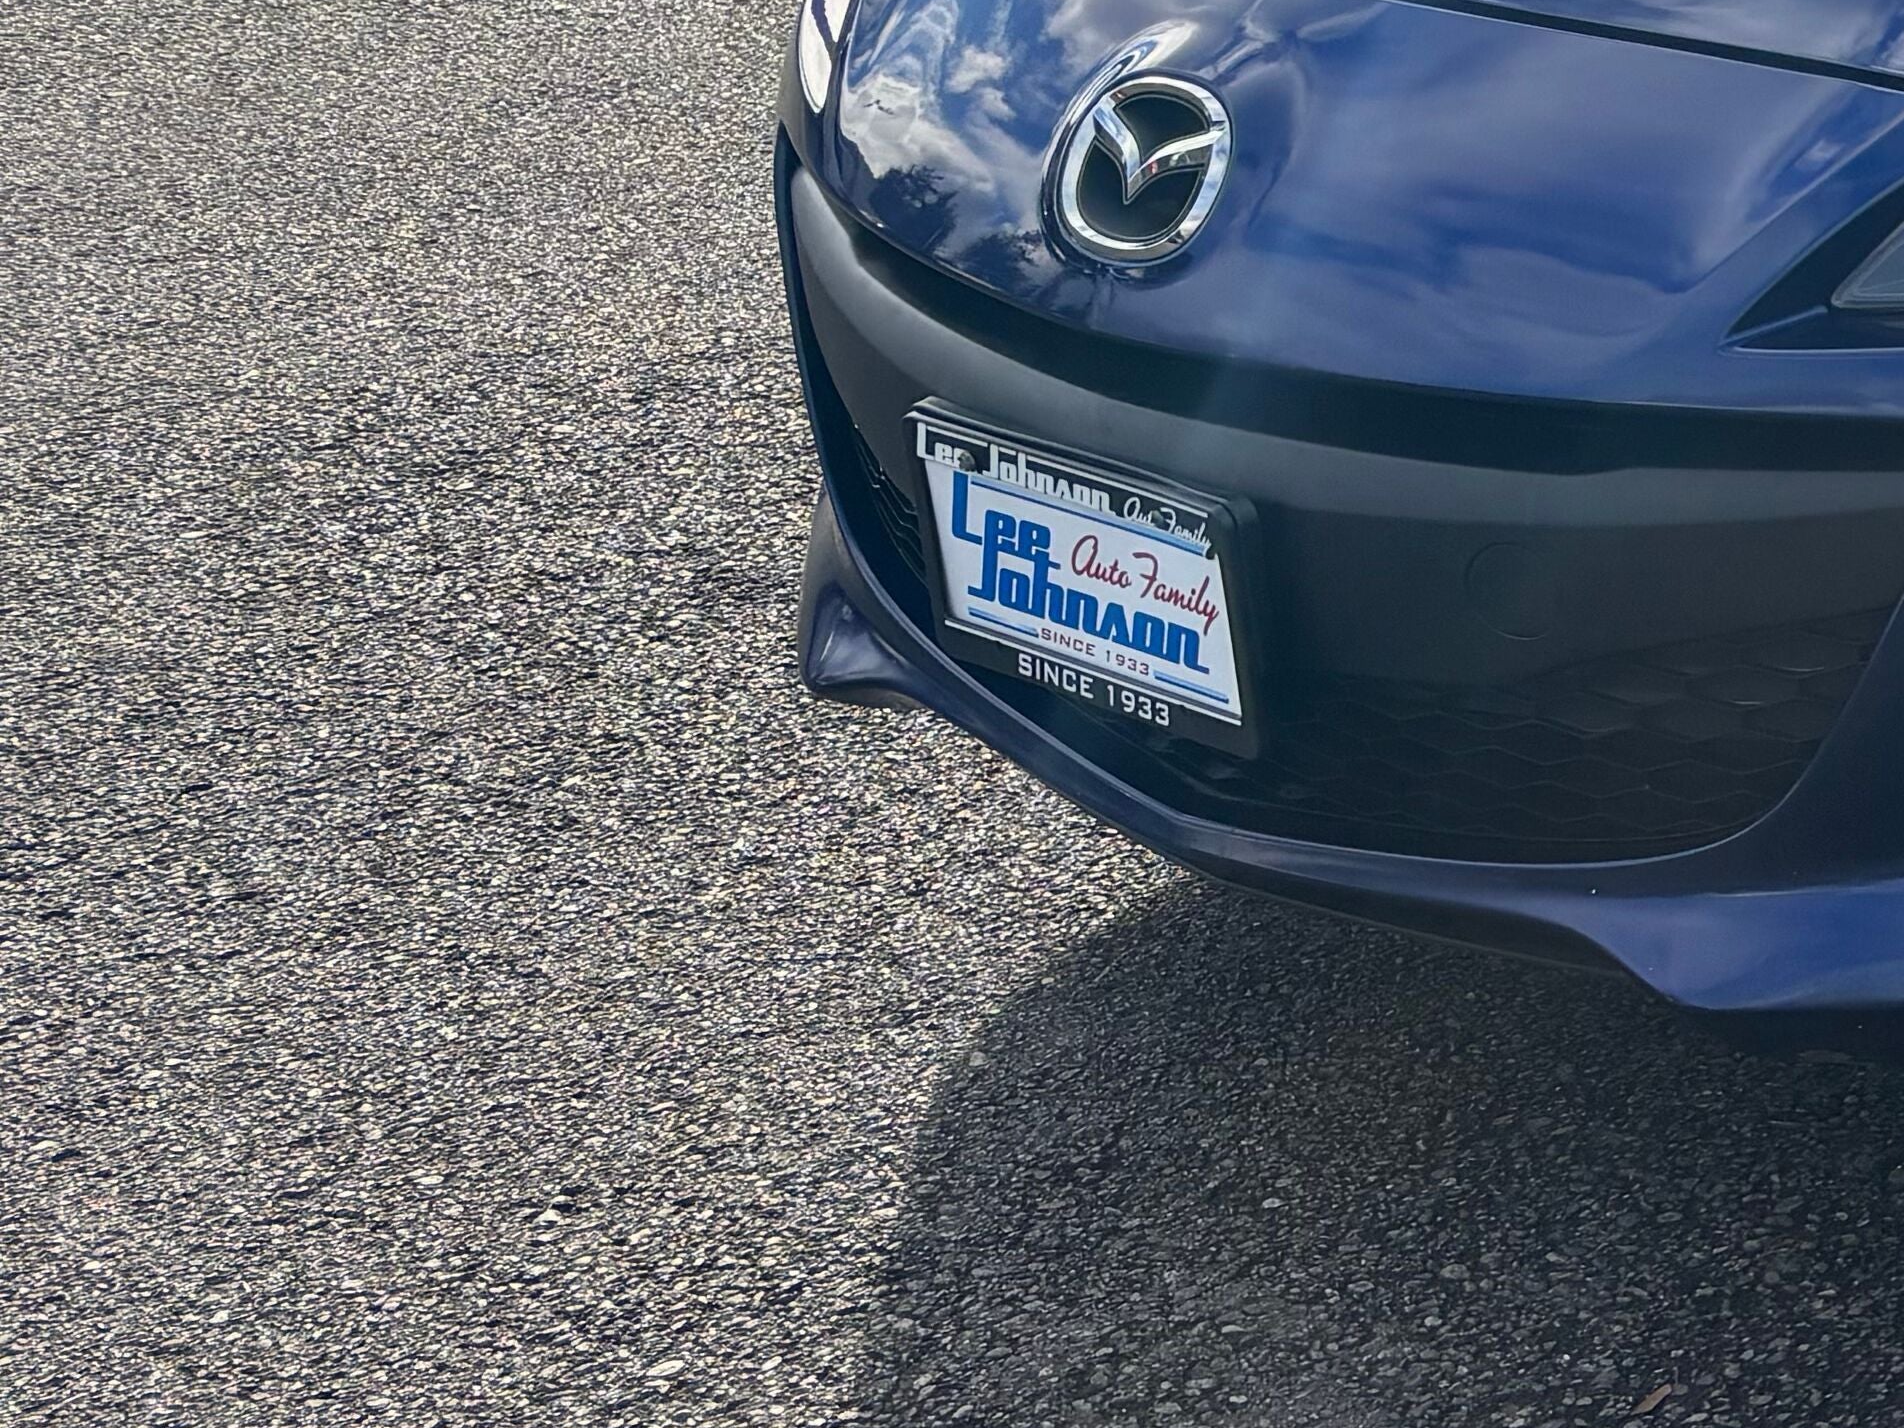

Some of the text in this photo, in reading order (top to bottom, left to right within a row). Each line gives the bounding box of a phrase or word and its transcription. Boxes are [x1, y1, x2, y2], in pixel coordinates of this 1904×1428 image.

[952, 471, 1220, 635] Lee Auto Family
[982, 443, 1117, 517] Johnson
[1123, 496, 1164, 527] Aut
[1160, 507, 1212, 557] Family
[967, 542, 1210, 674] Johnson
[1040, 626, 1151, 676] SINCE 1933
[1018, 654, 1171, 727] SINCE 1933
